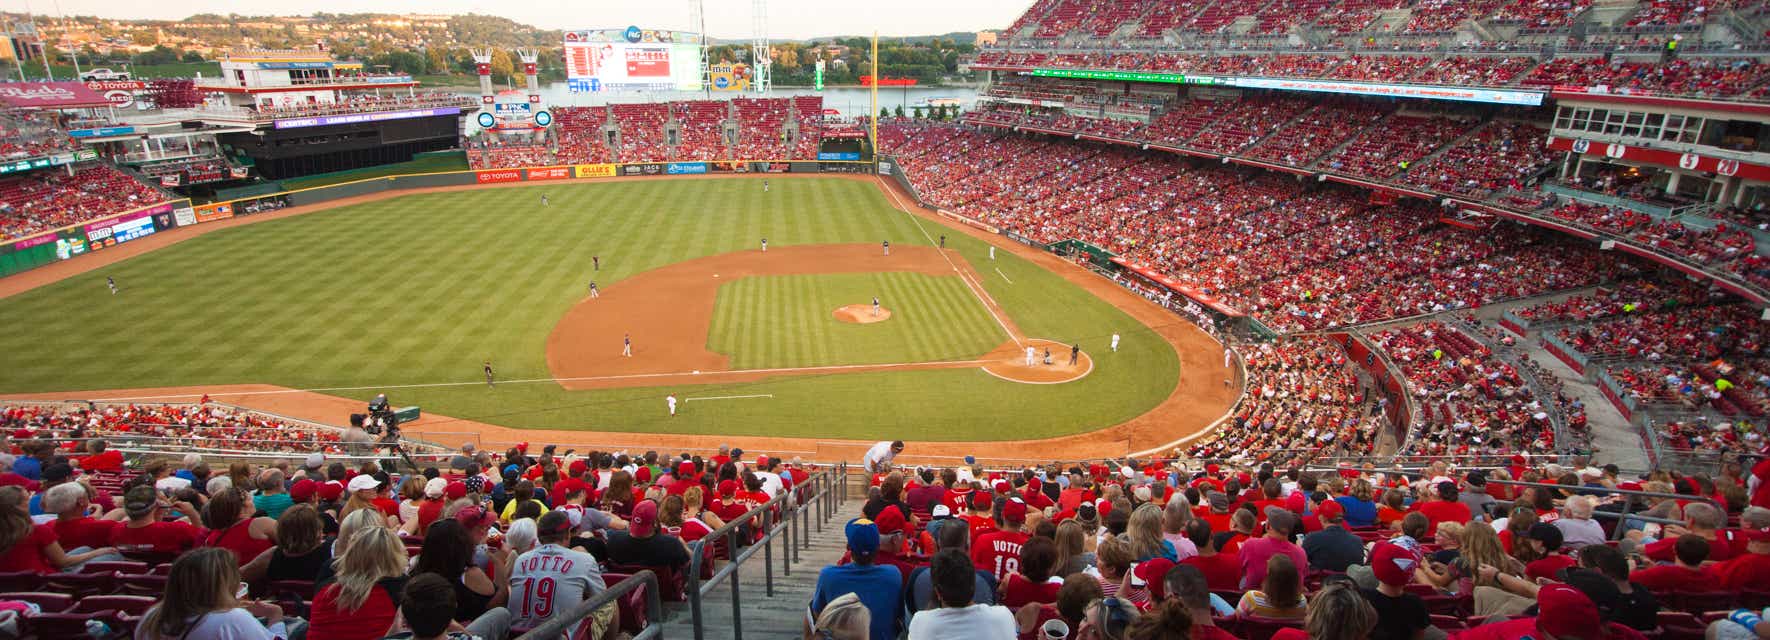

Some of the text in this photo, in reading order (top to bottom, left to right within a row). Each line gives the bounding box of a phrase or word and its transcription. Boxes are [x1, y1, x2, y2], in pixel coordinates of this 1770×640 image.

[103, 81, 140, 89] TOYOTA
[1685, 153, 1694, 167] 5
[521, 555, 574, 574] VOTTO
[520, 577, 556, 619] 19
